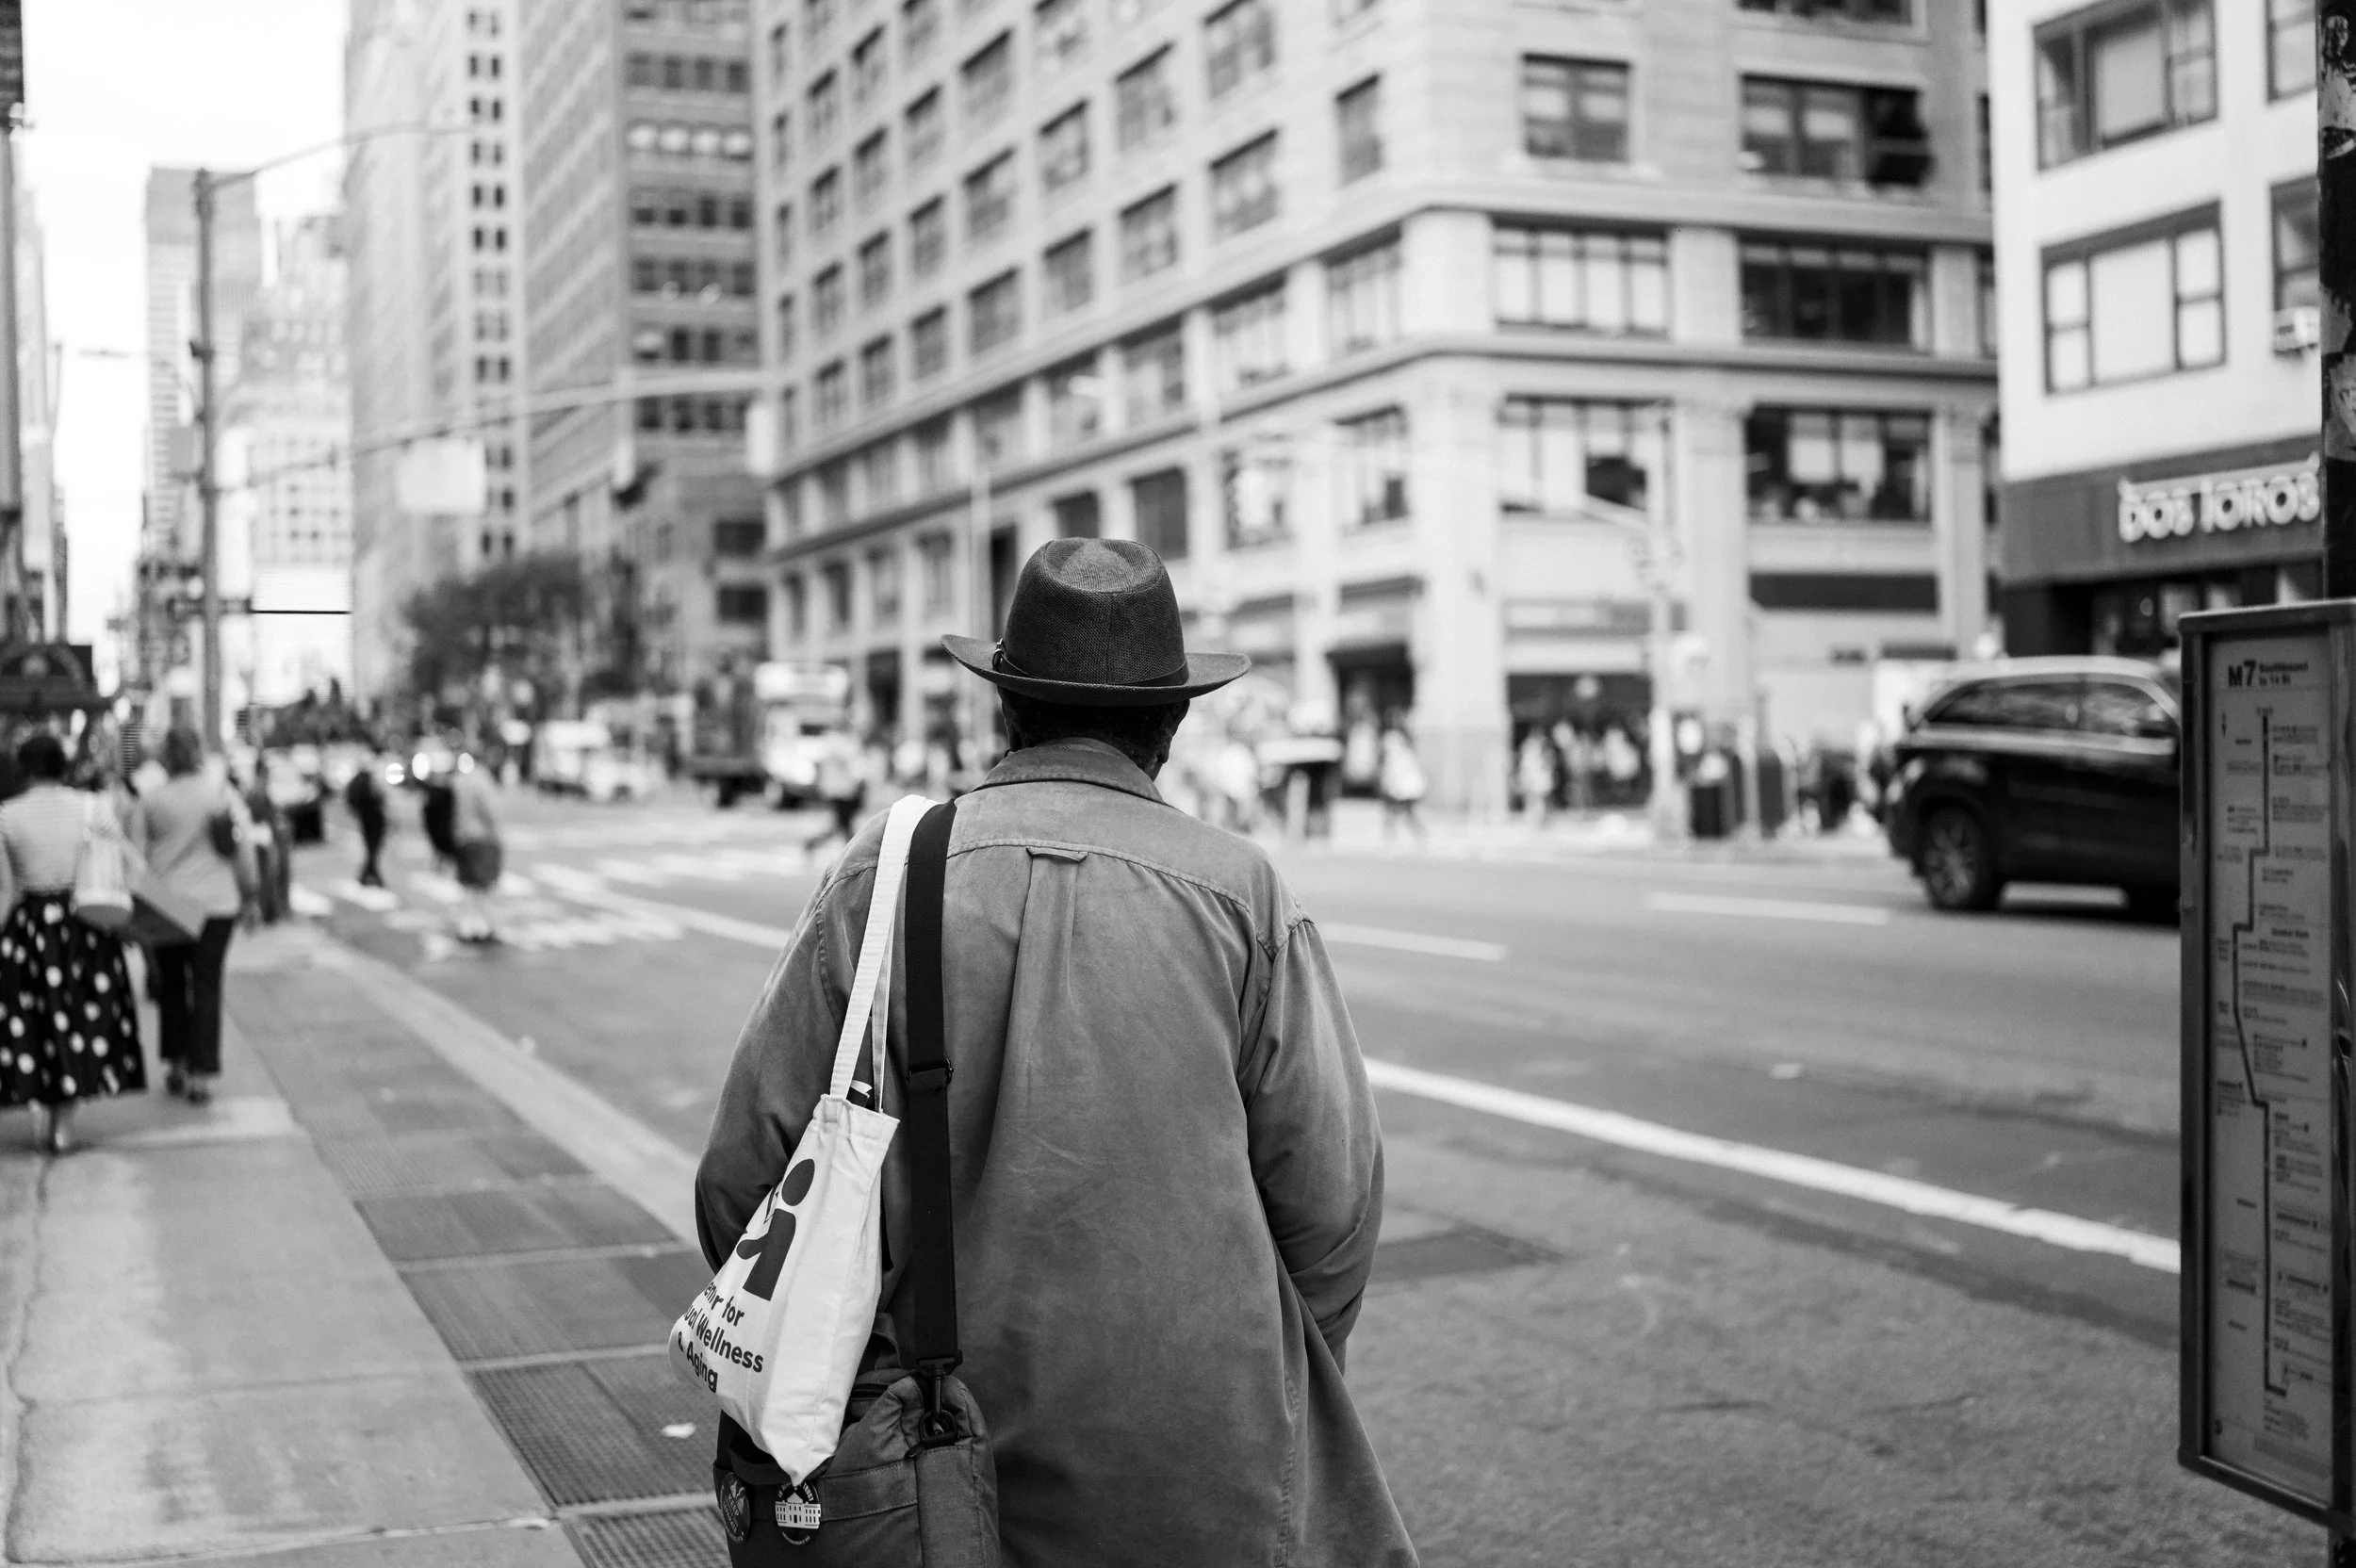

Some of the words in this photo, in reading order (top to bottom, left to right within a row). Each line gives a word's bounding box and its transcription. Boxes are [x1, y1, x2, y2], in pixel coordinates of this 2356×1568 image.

[2228, 659, 2256, 687] M7
[721, 1296, 745, 1327] for
[695, 1313, 764, 1374] Wellness
[686, 1340, 719, 1394] Aging
